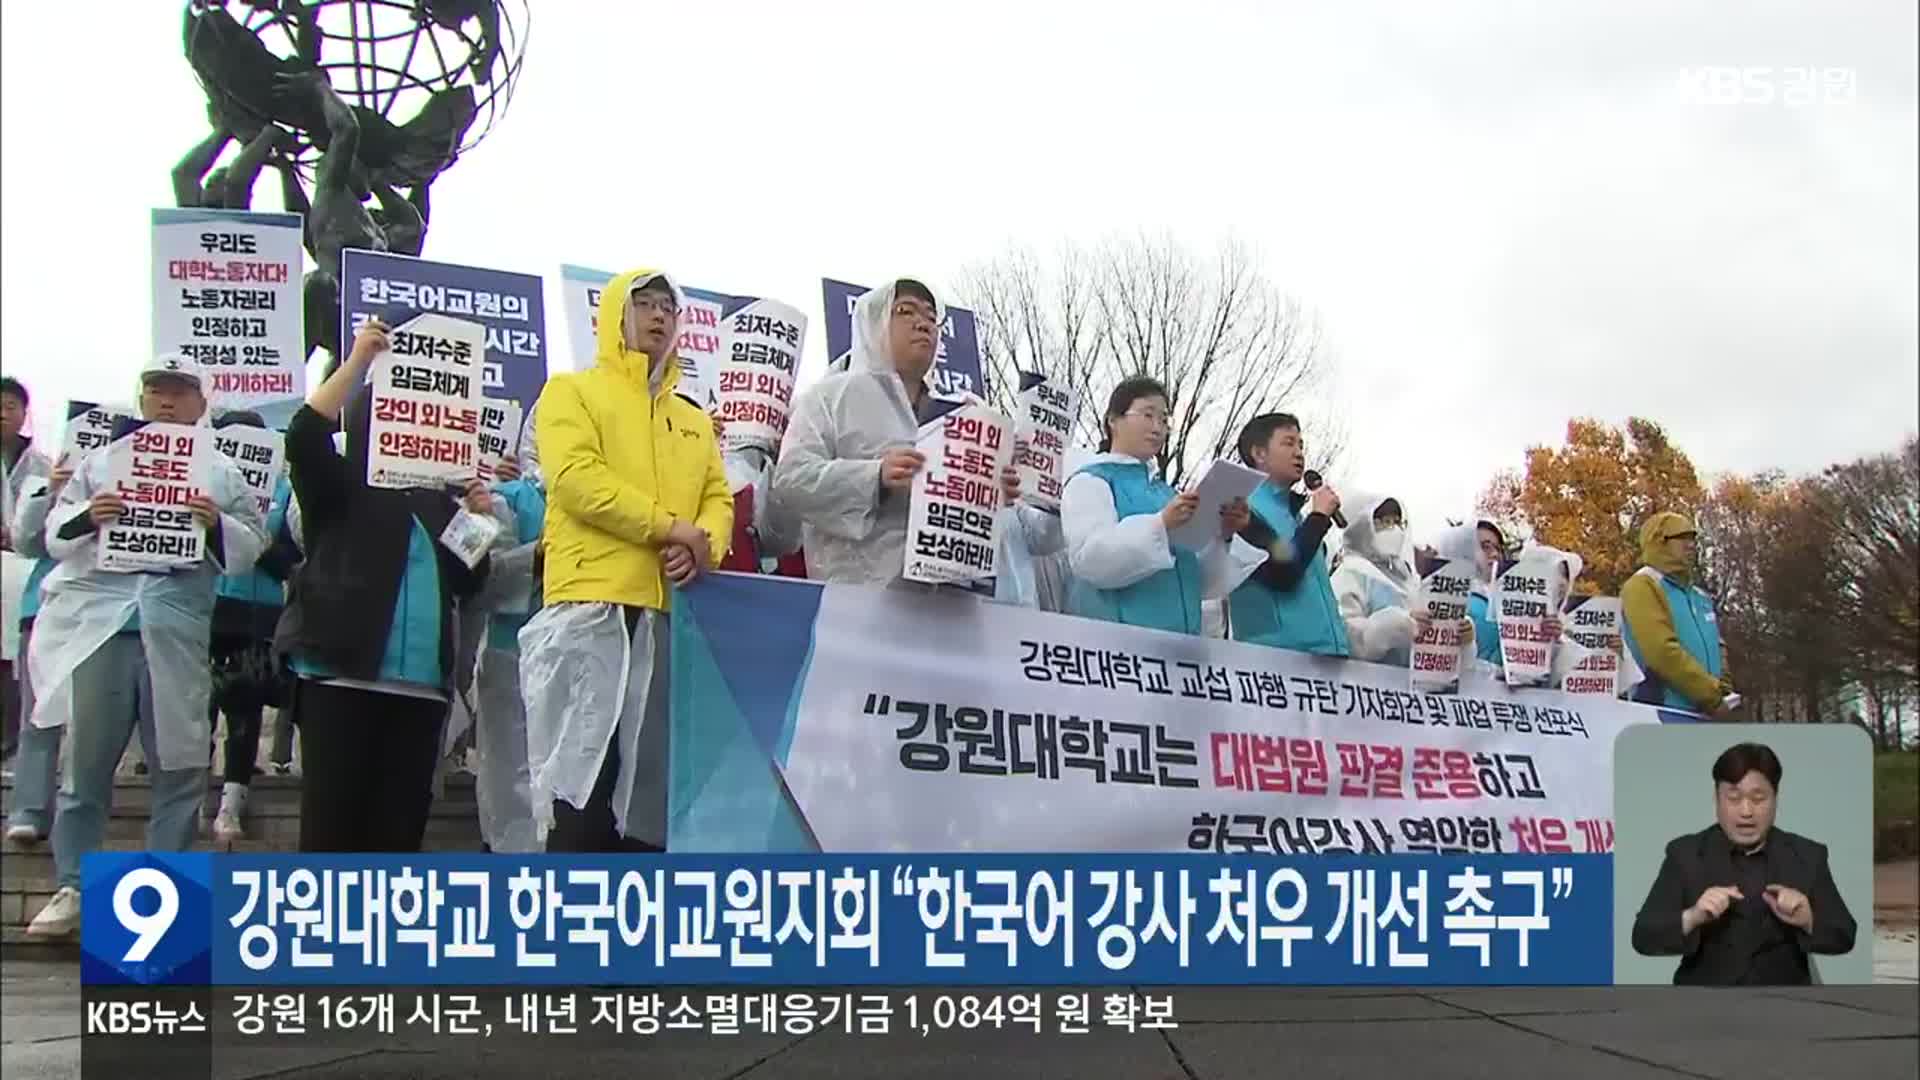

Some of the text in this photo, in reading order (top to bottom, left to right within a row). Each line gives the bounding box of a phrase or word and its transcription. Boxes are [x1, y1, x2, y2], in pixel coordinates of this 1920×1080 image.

[201, 233, 256, 253] 우리도
[169, 260, 287, 283] 대학노동자다!
[182, 288, 276, 311] 노동자권리
[360, 276, 529, 321] 한국어교원의
[192, 317, 267, 337] 인정하고
[734, 313, 799, 348] 최저수준
[243, 345, 280, 366] 있는
[391, 331, 472, 366] 최저수준
[731, 342, 794, 376] 임금체계
[212, 373, 293, 393] 재개하라!
[391, 365, 469, 399] 임금체계
[719, 371, 752, 392] 강의
[755, 373, 775, 396] 외
[375, 397, 478, 434] 강의 외 노동
[132, 431, 194, 457] 강의 외
[943, 415, 1002, 450] 강의 외
[240, 443, 273, 465] 파행
[379, 431, 471, 466] 인정하라!!
[943, 444, 995, 480] 노동도
[131, 457, 188, 482] 노동도
[116, 480, 200, 505] 노동이다!
[924, 471, 999, 512] 노동이다!
[118, 506, 193, 532] 임금으로
[927, 502, 993, 541] 임금으로
[106, 530, 197, 558] 보상하라!!
[915, 530, 994, 571] 보상하라!!
[1502, 575, 1547, 596] 최저수준
[1574, 610, 1616, 627] 최저수준
[1020, 640, 1591, 739] 강원대학교 교섭 파행 규탄 기자회견 및 파업 투쟁 선포식
[863, 693, 1546, 800] "강원대학교는 대법원 판결 준용하고
